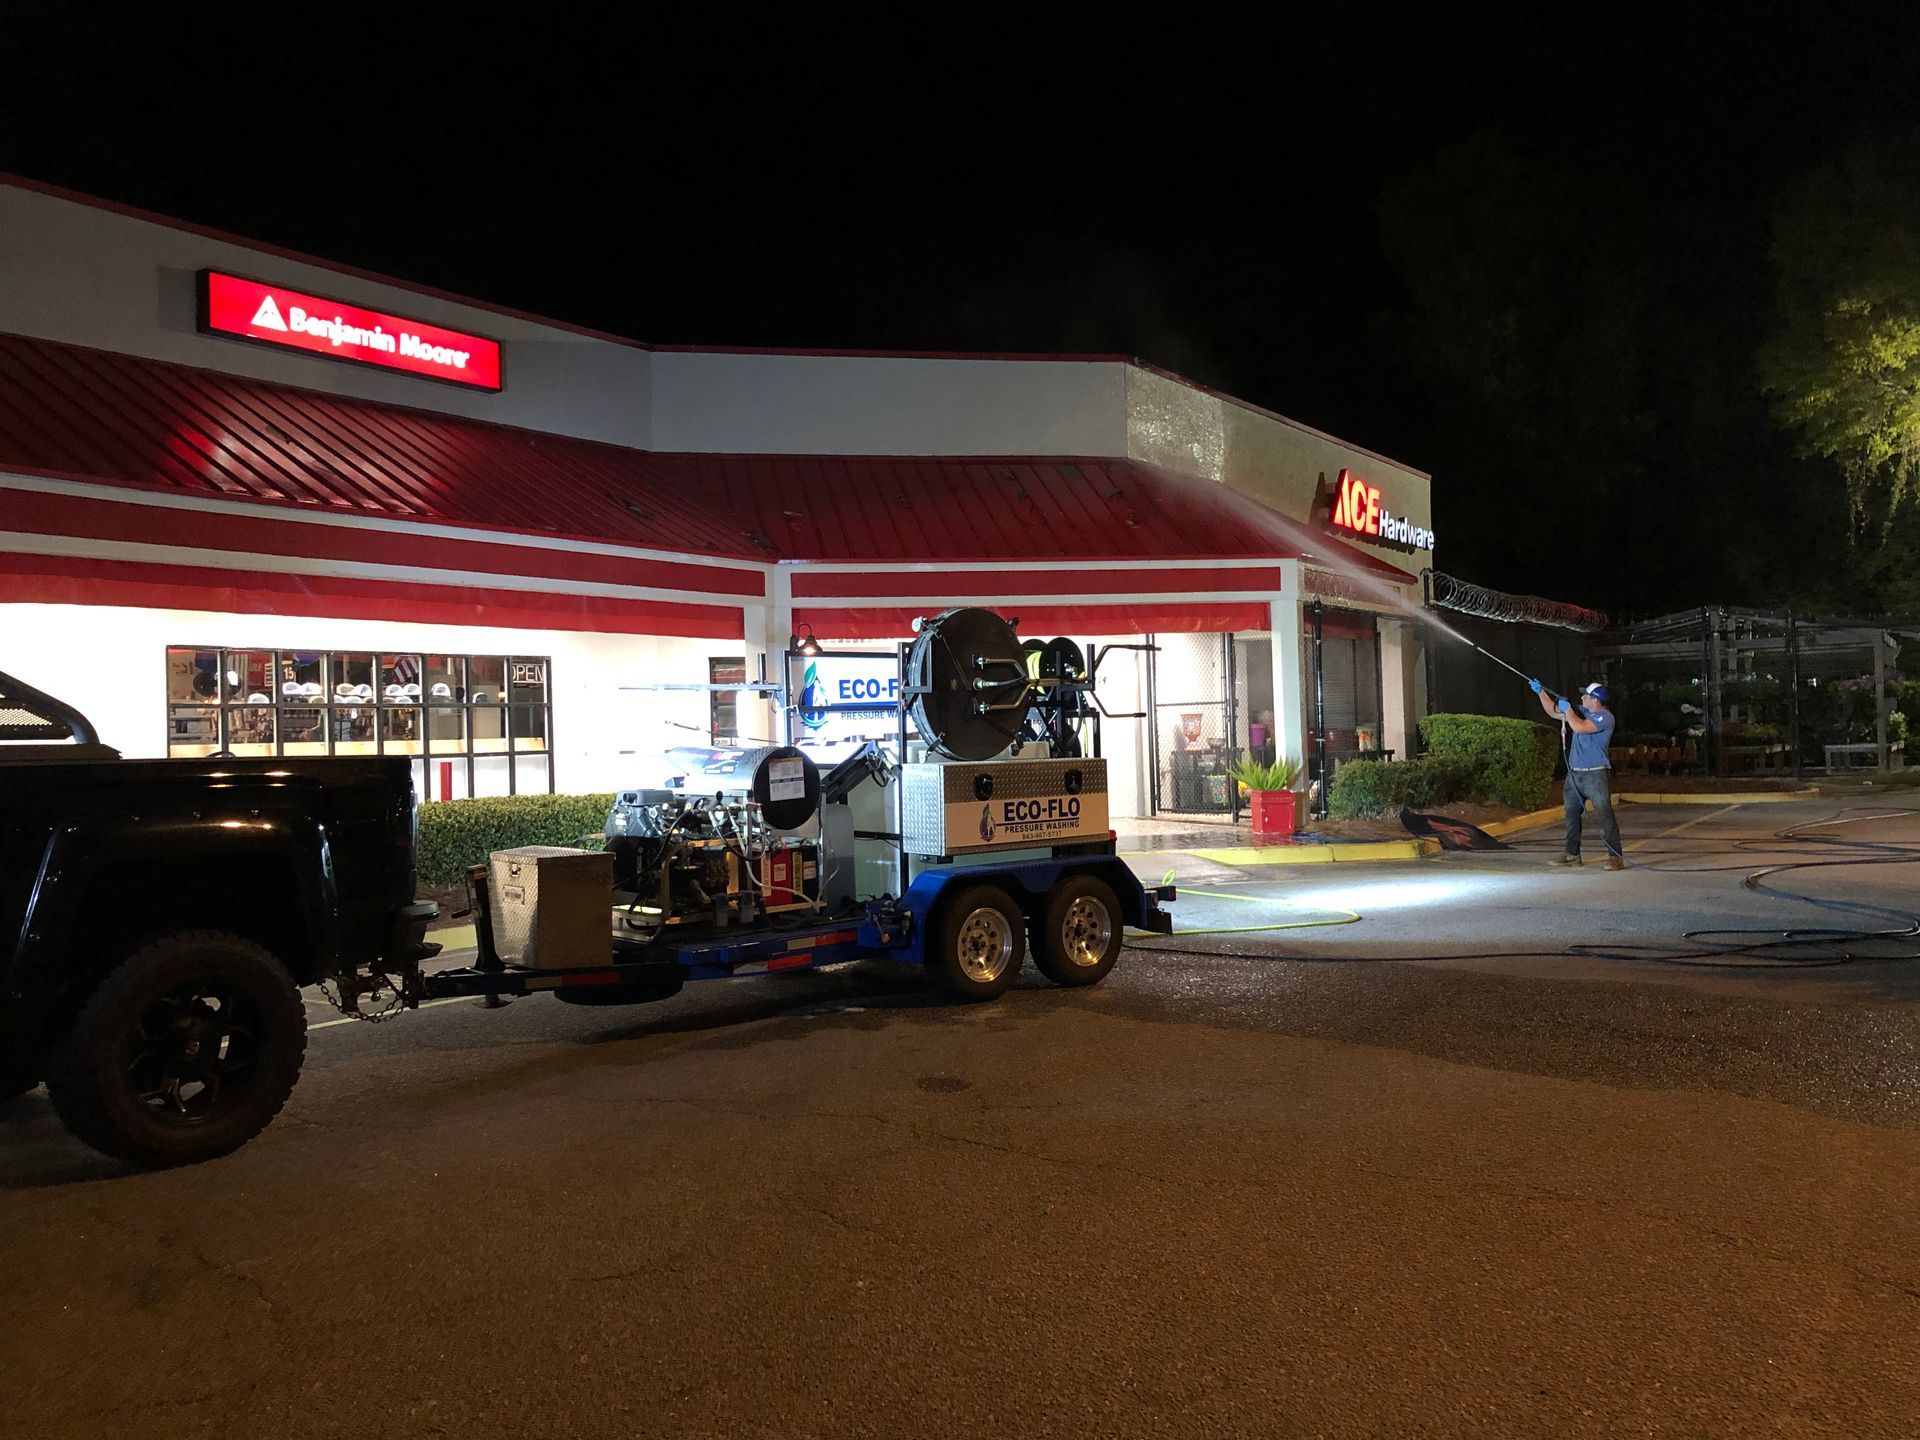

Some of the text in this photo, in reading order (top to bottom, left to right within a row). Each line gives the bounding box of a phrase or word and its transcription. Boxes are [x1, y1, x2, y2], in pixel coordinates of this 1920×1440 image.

[289, 306, 470, 369] Benjamin Moore
[1333, 468, 1435, 550] ACE Hardware
[838, 678, 899, 699] ECO-F
[841, 711, 885, 720] PRESSURE
[1004, 798, 1080, 821] ECO-FLO
[1004, 820, 1080, 833] PRESSURE WASHING
